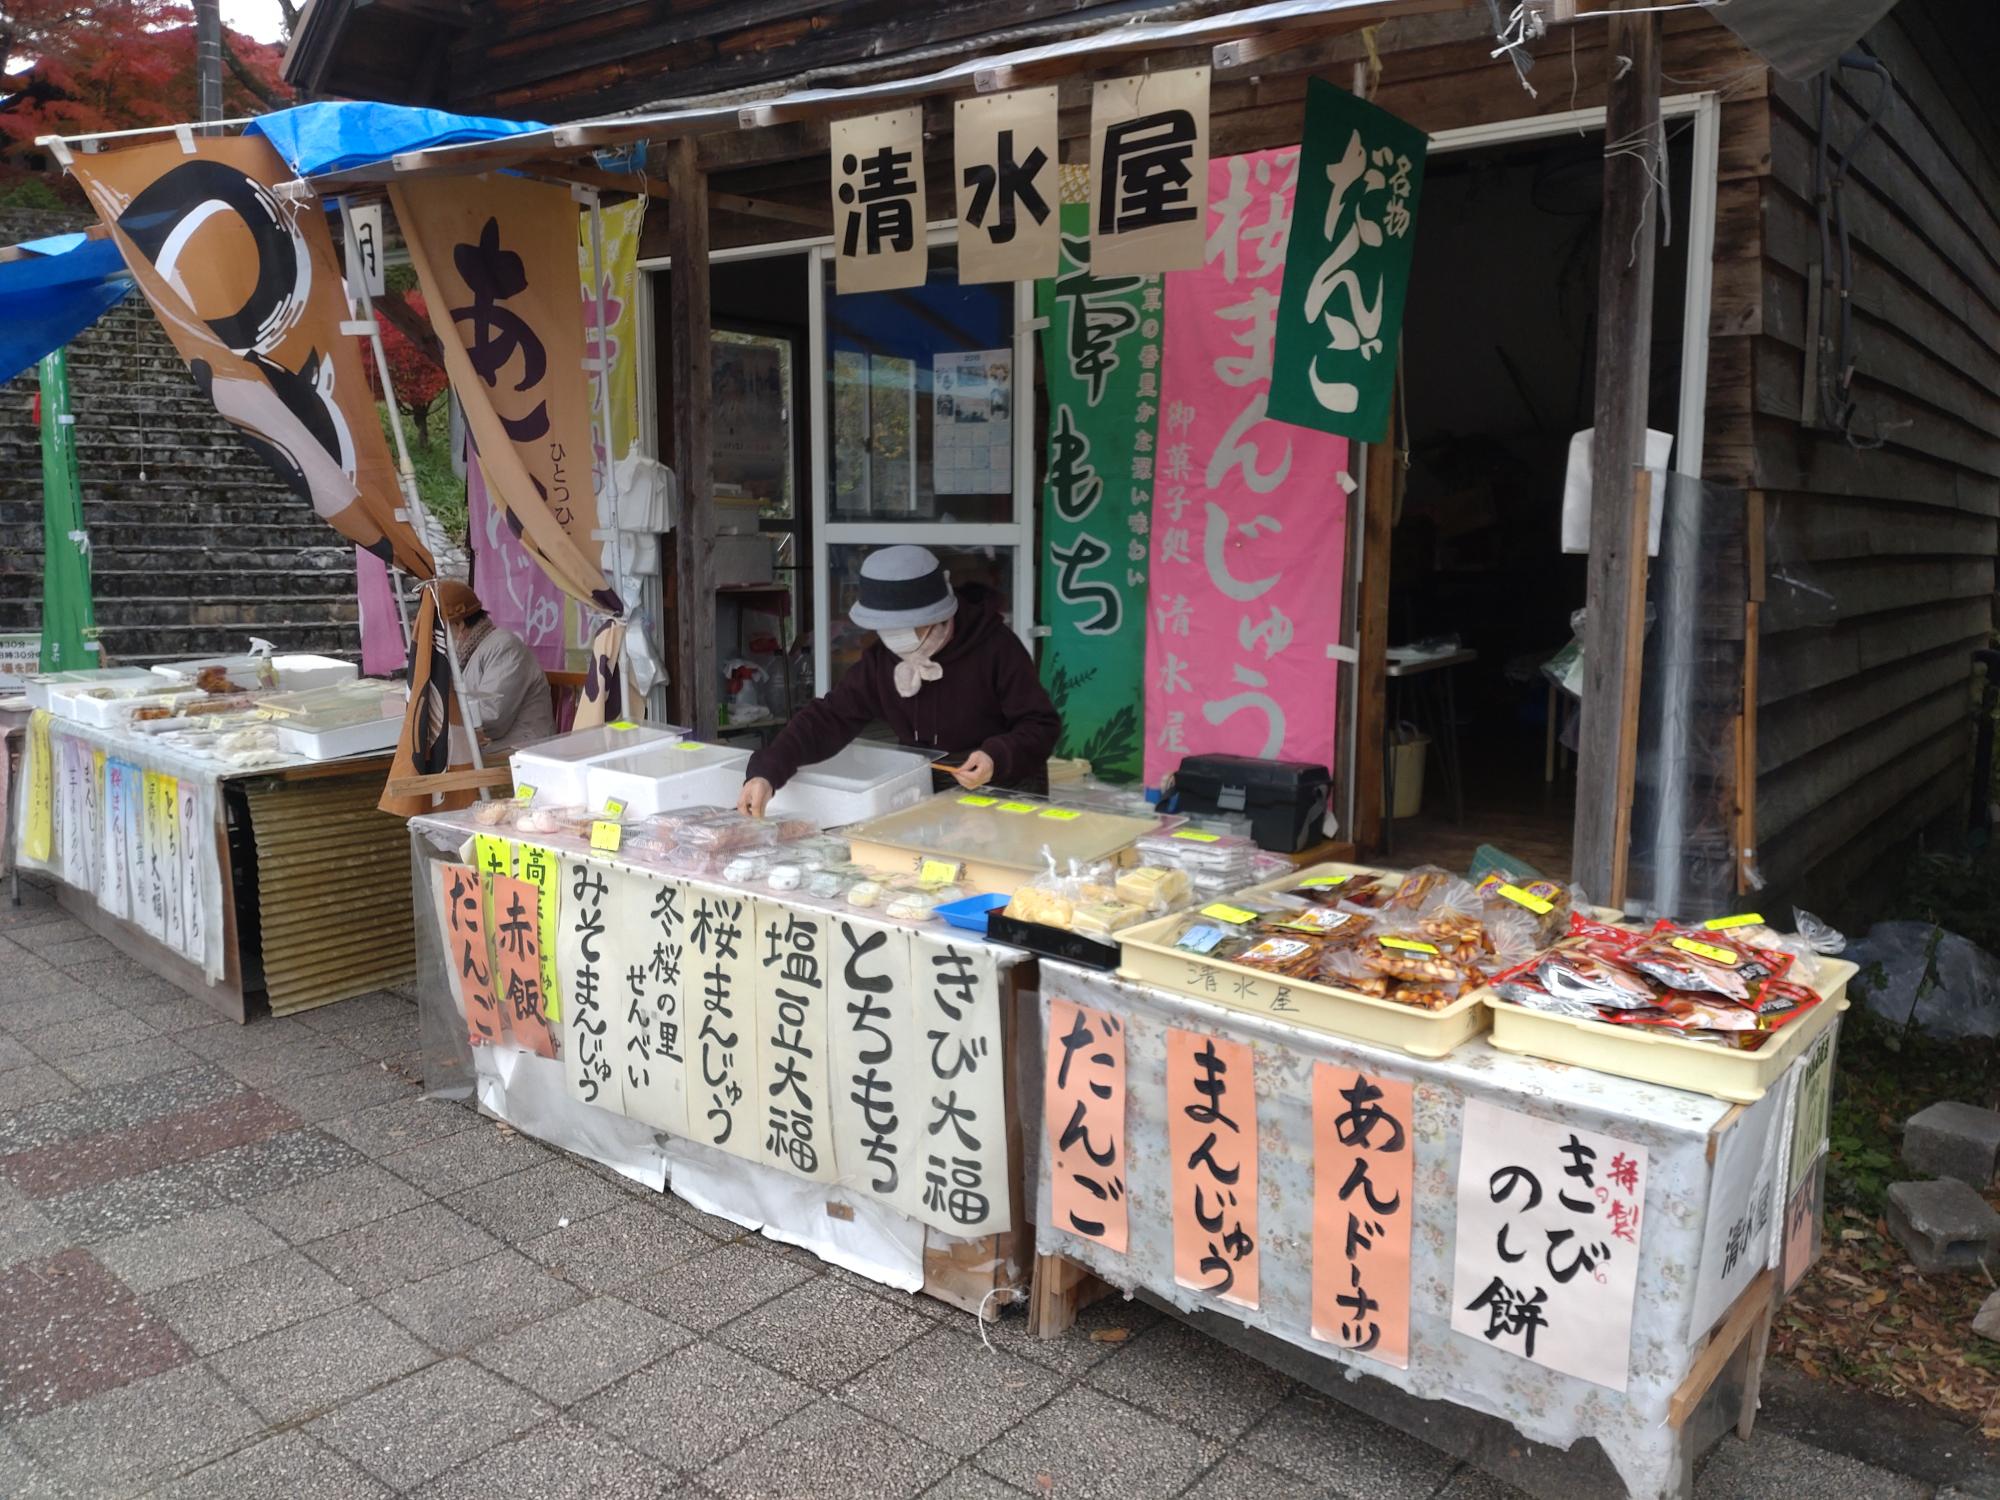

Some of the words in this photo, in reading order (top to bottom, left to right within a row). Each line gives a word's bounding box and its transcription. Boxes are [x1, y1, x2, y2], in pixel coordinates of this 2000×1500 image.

[838, 108, 1198, 258] 清水屋
[1304, 128, 1386, 414] だんご
[1382, 154, 1412, 239] 名物
[550, 442, 575, 536] ひとつひ
[1202, 148, 1300, 761] 桜まんじゅう
[1154, 595, 1196, 756] 清水屋
[184, 796, 200, 938] のしもち
[449, 870, 497, 1037] だんご
[499, 890, 548, 1027] 赤飯
[572, 864, 612, 1103] みそまんじゅう
[625, 964, 651, 1089] せんべい
[649, 884, 685, 1064] 冬桜の里
[689, 897, 743, 1145] 桜まんじゅう
[762, 911, 823, 1174] 塩豆大福
[1186, 962, 1300, 1013] 清水屋
[840, 920, 899, 1194] とちもち
[921, 943, 990, 1225] きび大福
[1058, 1009, 1125, 1237] だんご
[1183, 1038, 1255, 1297] まんじゅう
[1334, 1074, 1406, 1352] あんドーナツ
[1544, 1133, 1611, 1284] きび
[1720, 1180, 1771, 1280] 清水屋
[1465, 1165, 1550, 1358] のし餅
